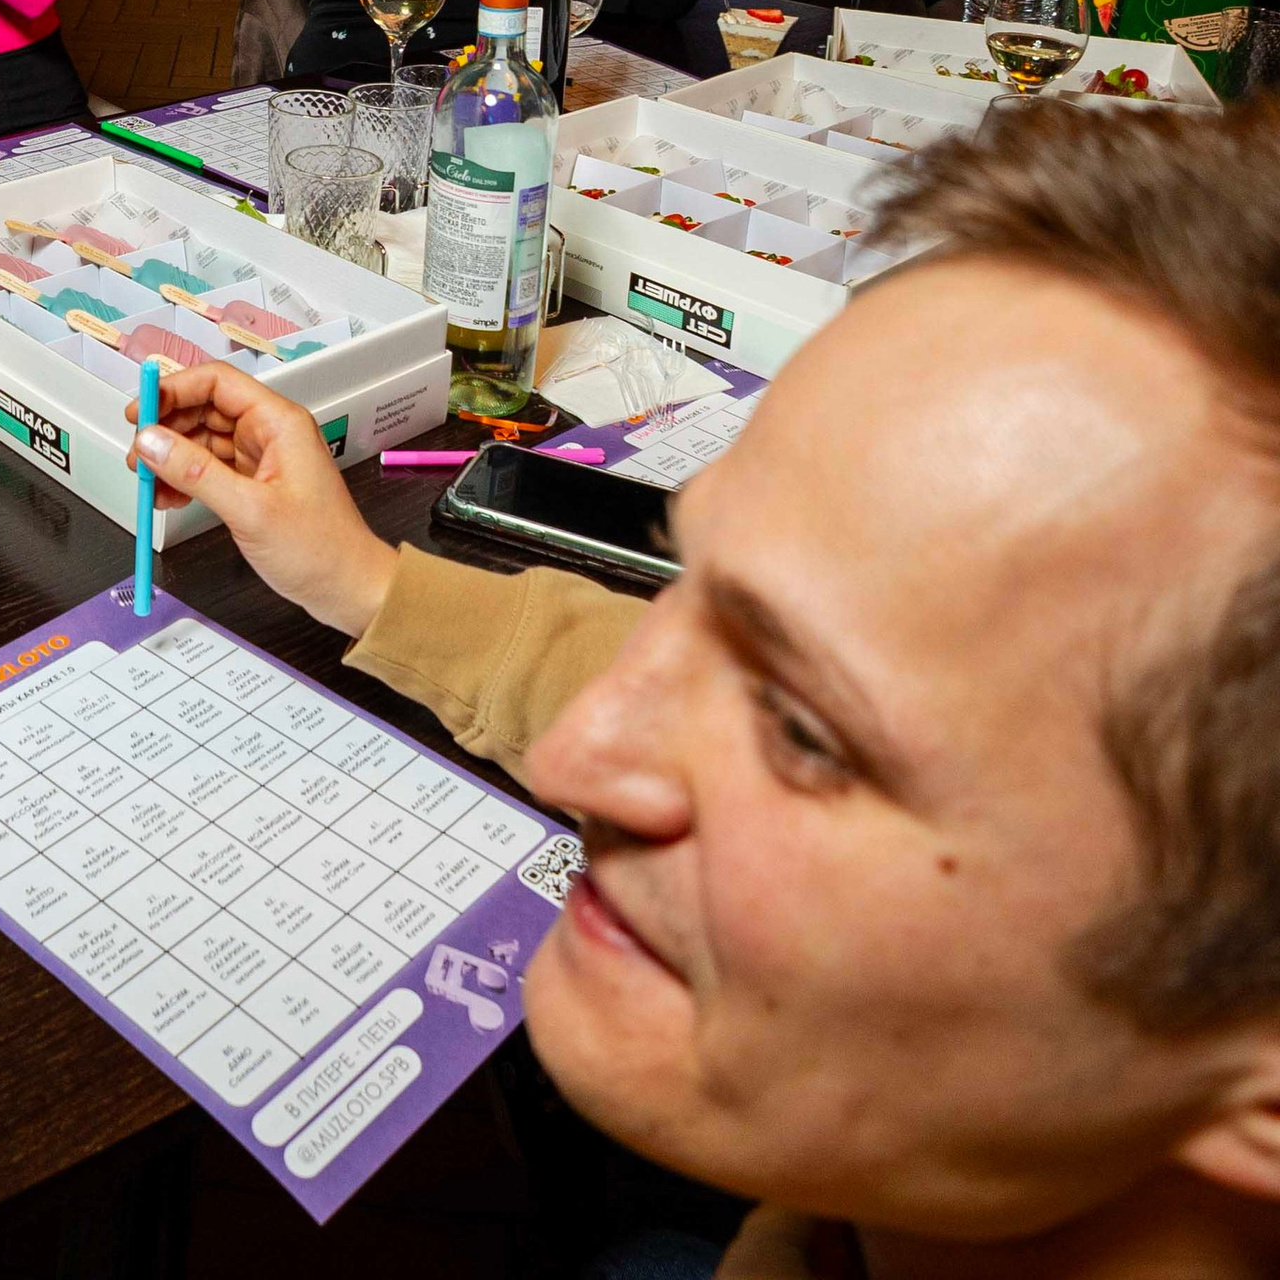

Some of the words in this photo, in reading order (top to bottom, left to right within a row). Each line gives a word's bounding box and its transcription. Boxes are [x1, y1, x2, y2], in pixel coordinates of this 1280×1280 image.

[446, 164, 471, 182] Cielo
[439, 205, 459, 220] РЕГИОН
[460, 212, 486, 226] ВЕНЕТО.
[634, 277, 717, 321] ФУРШЕТ
[472, 316, 498, 328] simple
[685, 317, 727, 343] СЕТ
[32, 434, 65, 468] СЕТ
[16, 673, 62, 702] КАРАОКЕ
[60, 666, 75, 676] 1.0
[283, 1100, 301, 1120] В
[296, 1051, 355, 1108] ПИТЕРЕ
[357, 1009, 401, 1051] ПЕТЬ!
